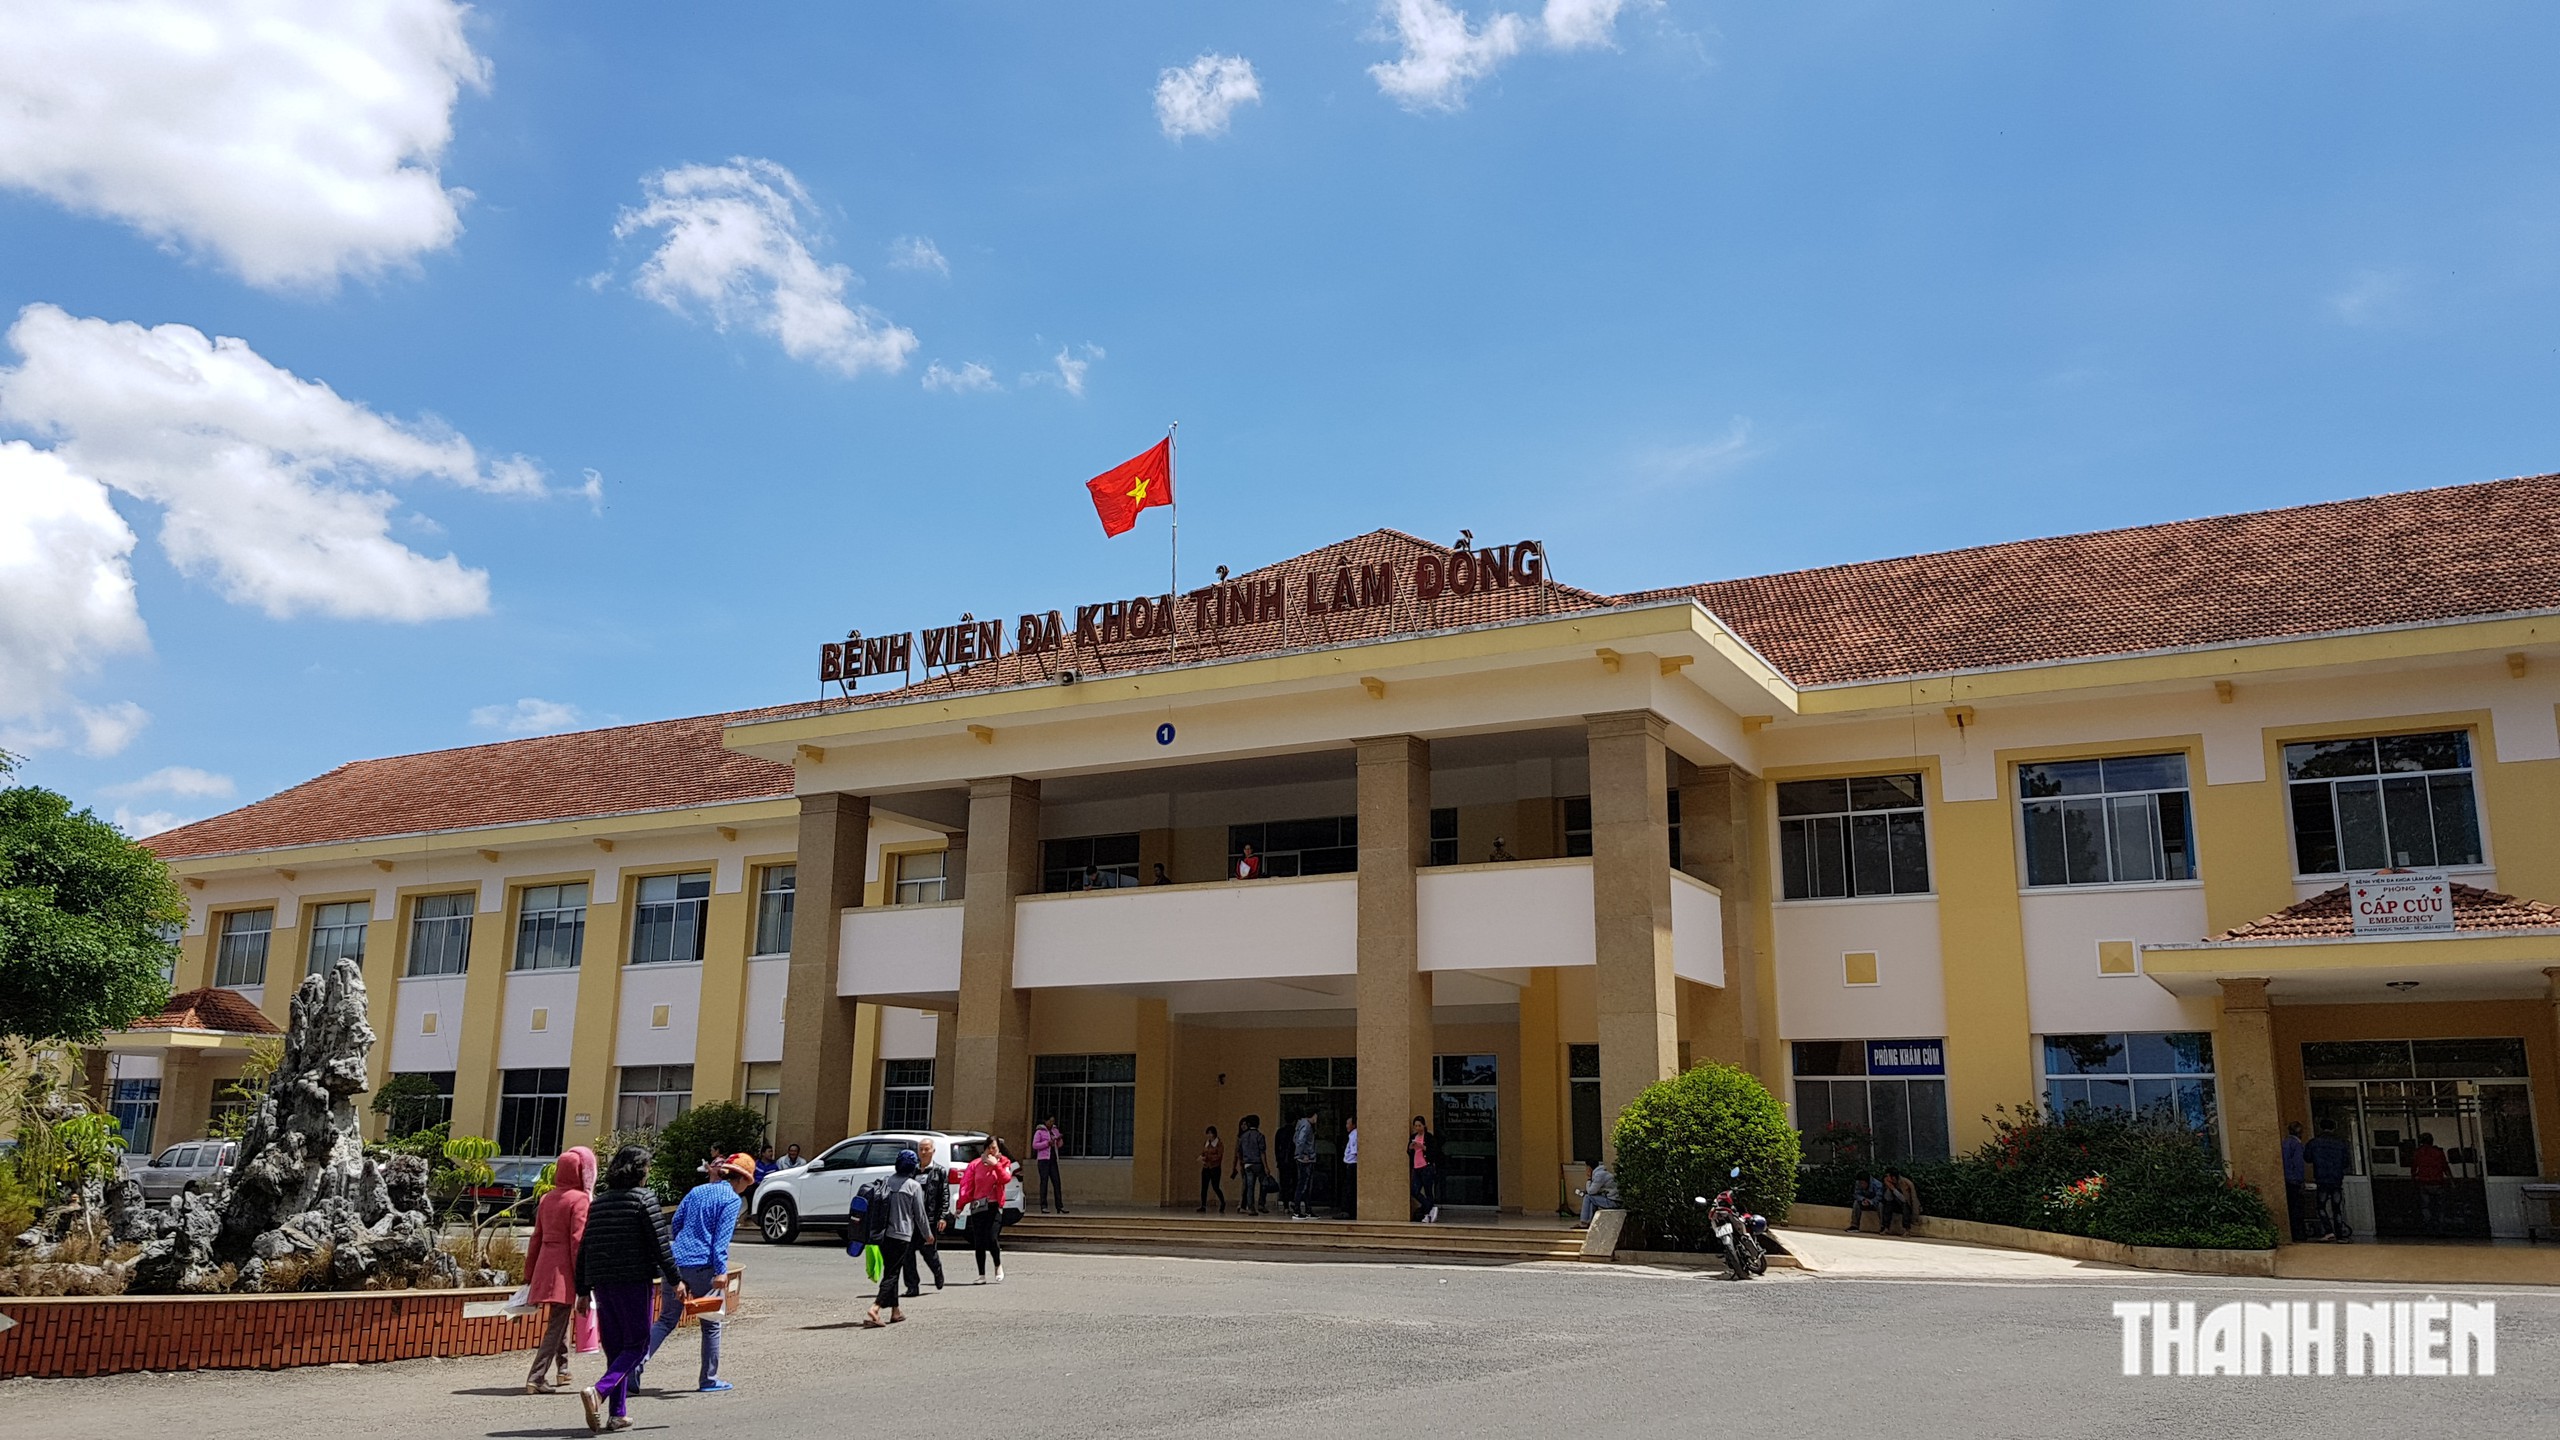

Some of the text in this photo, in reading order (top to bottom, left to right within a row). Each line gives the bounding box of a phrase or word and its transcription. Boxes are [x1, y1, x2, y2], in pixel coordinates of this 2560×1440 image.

[821, 529, 1541, 690] BỆNH VIỆN ĐA KHOA TỈNH LÂM ĐỒNG
[1161, 727, 1169, 741] 1
[2383, 885, 2416, 893] PHÒNG
[2360, 894, 2442, 915] CẤP CỨU
[2368, 914, 2434, 924] EMERGENCY
[1874, 1045, 1940, 1066] PHÒNG KHÁM CÚM
